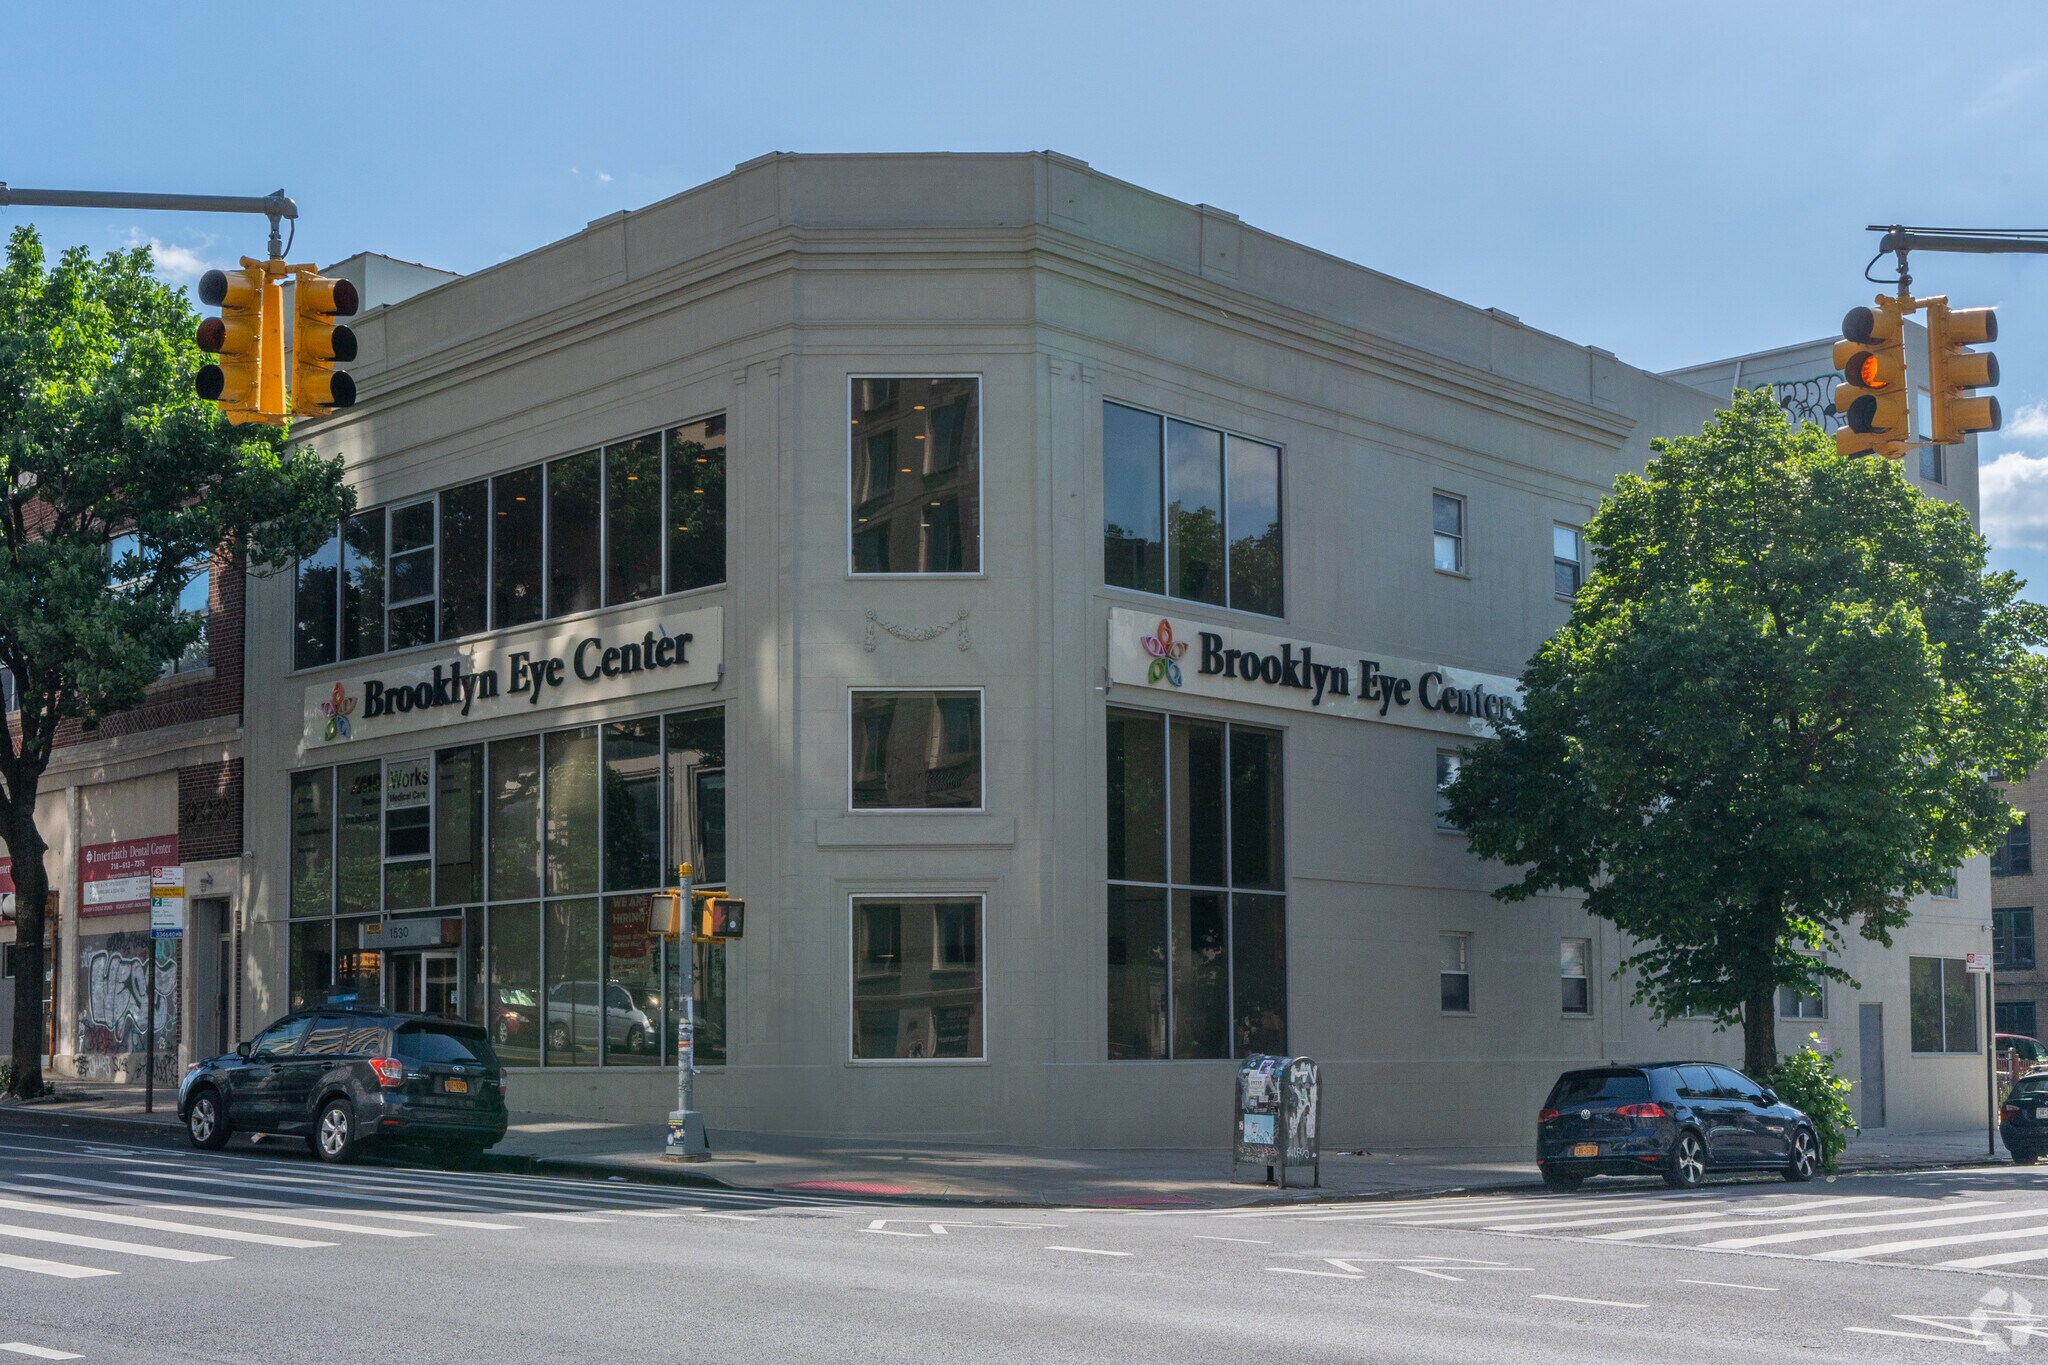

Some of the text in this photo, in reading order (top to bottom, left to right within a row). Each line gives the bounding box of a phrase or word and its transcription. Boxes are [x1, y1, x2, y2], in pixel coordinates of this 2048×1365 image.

[362, 630, 693, 718] Brooklyn Eye Center
[1198, 631, 1512, 721] Brooklyn Eye Center
[390, 767, 429, 789] Works
[389, 791, 412, 802] Medical
[412, 790, 426, 800] Care
[93, 842, 172, 863] Interfaith Dental Center
[613, 895, 648, 908] WE ARE
[612, 912, 646, 924] HIRING
[389, 926, 409, 939] 1530
